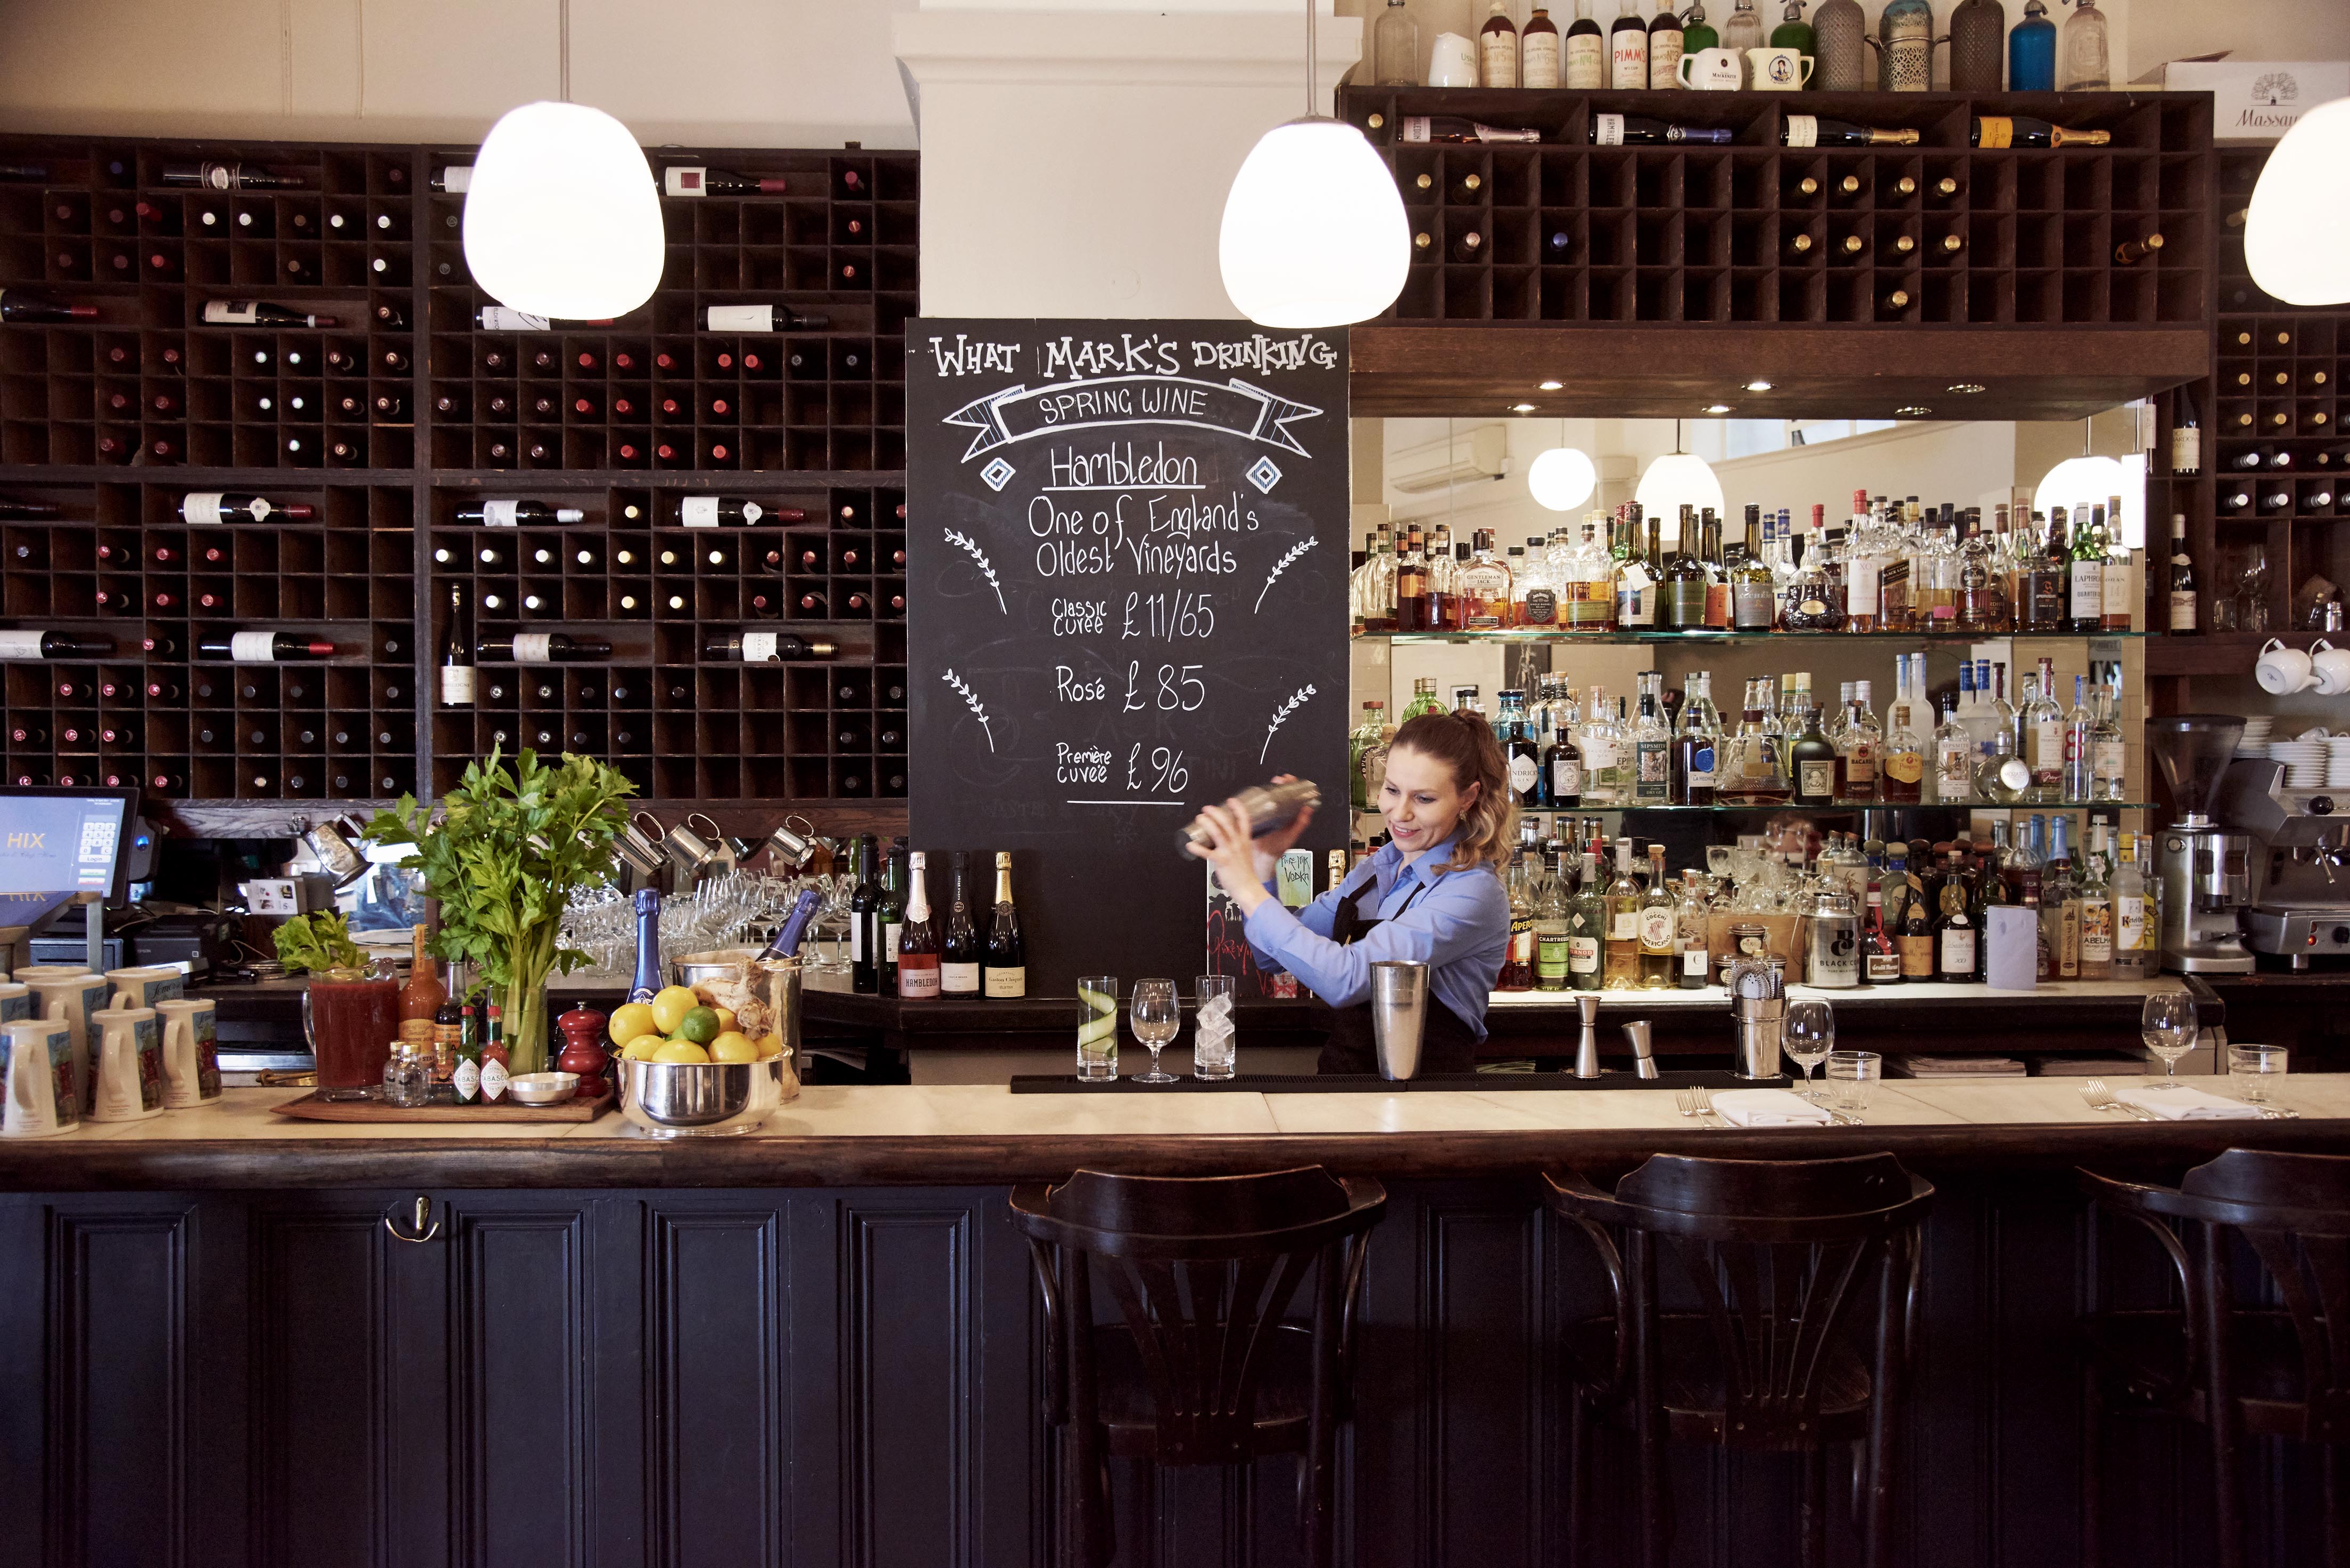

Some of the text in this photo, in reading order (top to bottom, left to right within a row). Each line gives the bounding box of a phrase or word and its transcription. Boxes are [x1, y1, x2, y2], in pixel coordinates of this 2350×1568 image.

[1615, 48, 1646, 63] PIMM'S
[1606, 118, 1615, 145] HAMBLED
[2236, 109, 2298, 133] Massay
[930, 333, 1338, 379] WHAT MARK'S DRINKING
[1039, 388, 1208, 424] SPRING WINE
[1051, 441, 1197, 487] Hambledon
[1029, 492, 1259, 549] One of England's
[1037, 534, 1237, 579] Oldest Vineyards
[1056, 665, 1106, 702] Rosé
[7, 833, 46, 849] HIX
[1284, 867, 1310, 886] VODKA
[1511, 920, 1533, 932] APERO
[1642, 934, 1671, 947] AMERICANO
[906, 978, 938, 988] HAMBLEDON
